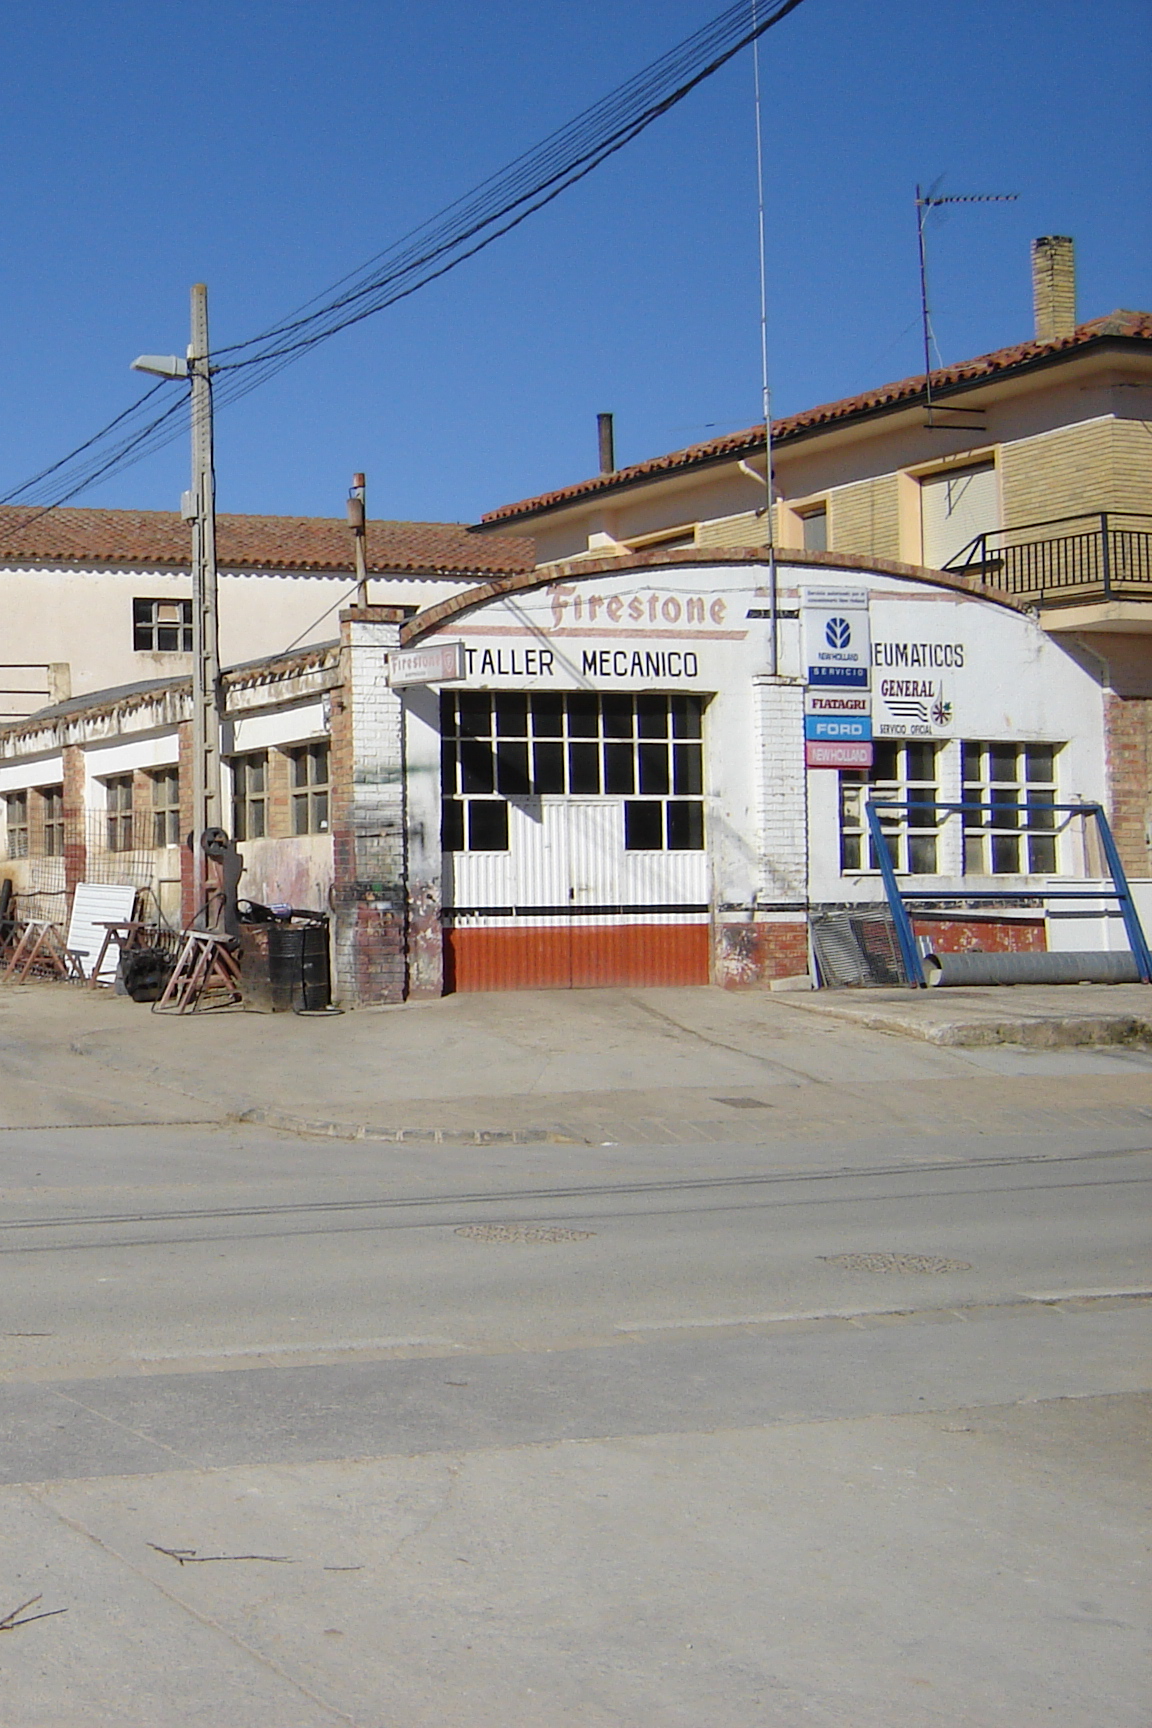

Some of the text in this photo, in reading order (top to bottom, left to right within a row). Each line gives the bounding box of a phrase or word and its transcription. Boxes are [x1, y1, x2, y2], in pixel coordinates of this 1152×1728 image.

[546, 584, 727, 628] Firestone
[465, 649, 697, 677] TALLER MECANICO
[870, 643, 963, 668] EUMATICOS
[813, 667, 864, 676] SERVICIO
[881, 679, 934, 697] GENERAL
[812, 698, 866, 710] FIATAGRI
[816, 723, 862, 735] FORD
[880, 724, 932, 735] SERVICIO OFICIAL
